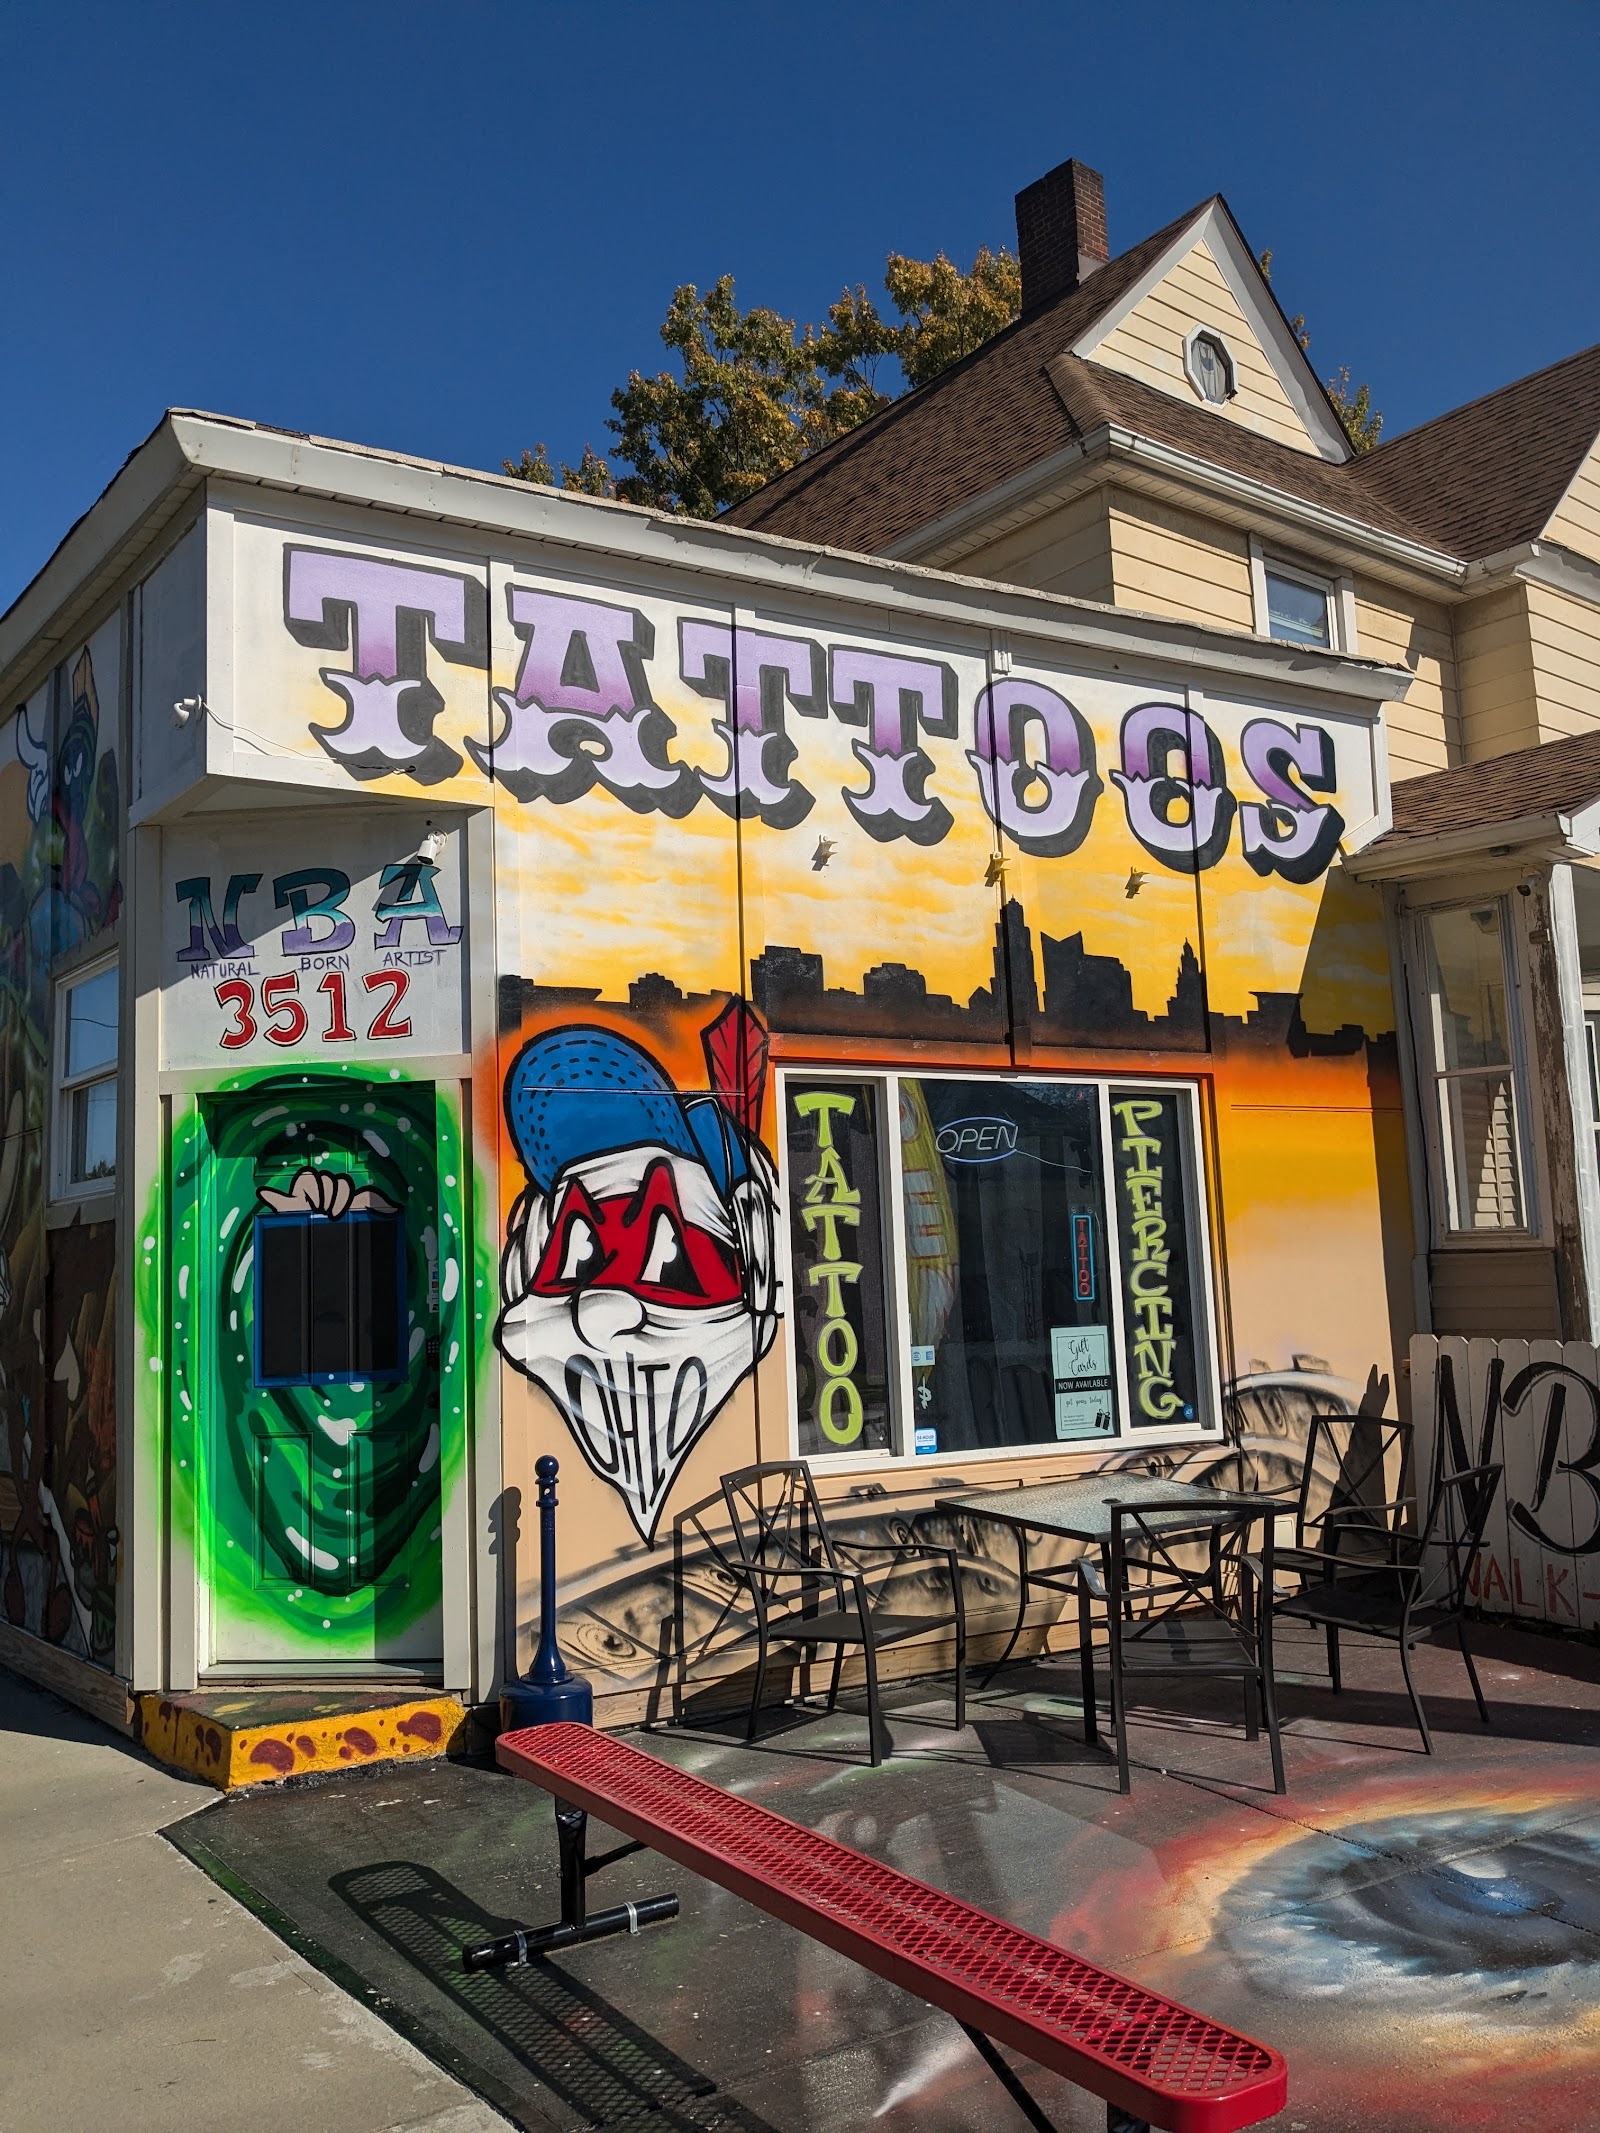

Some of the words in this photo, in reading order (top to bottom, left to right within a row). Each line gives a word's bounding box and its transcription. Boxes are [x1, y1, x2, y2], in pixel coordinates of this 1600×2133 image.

[282, 542, 1346, 885] TATTOOS
[175, 863, 465, 963] NBA
[190, 959, 261, 980] NATURAL
[297, 953, 351, 973] BORN
[382, 948, 447, 968] ARTIST
[213, 968, 413, 1050] 3512
[935, 1125, 1019, 1154] OPEN
[792, 1091, 864, 1446] TATTOO
[1077, 1218, 1092, 1296] TATTOO
[1112, 1099, 1186, 1420] PIERCING
[1058, 1381, 1074, 1391] NOW
[1075, 1378, 1109, 1389] AVAILABLE
[1067, 1337, 1090, 1361] Gift
[1067, 1354, 1098, 1377] Cards
[563, 1350, 708, 1515] OHIO
